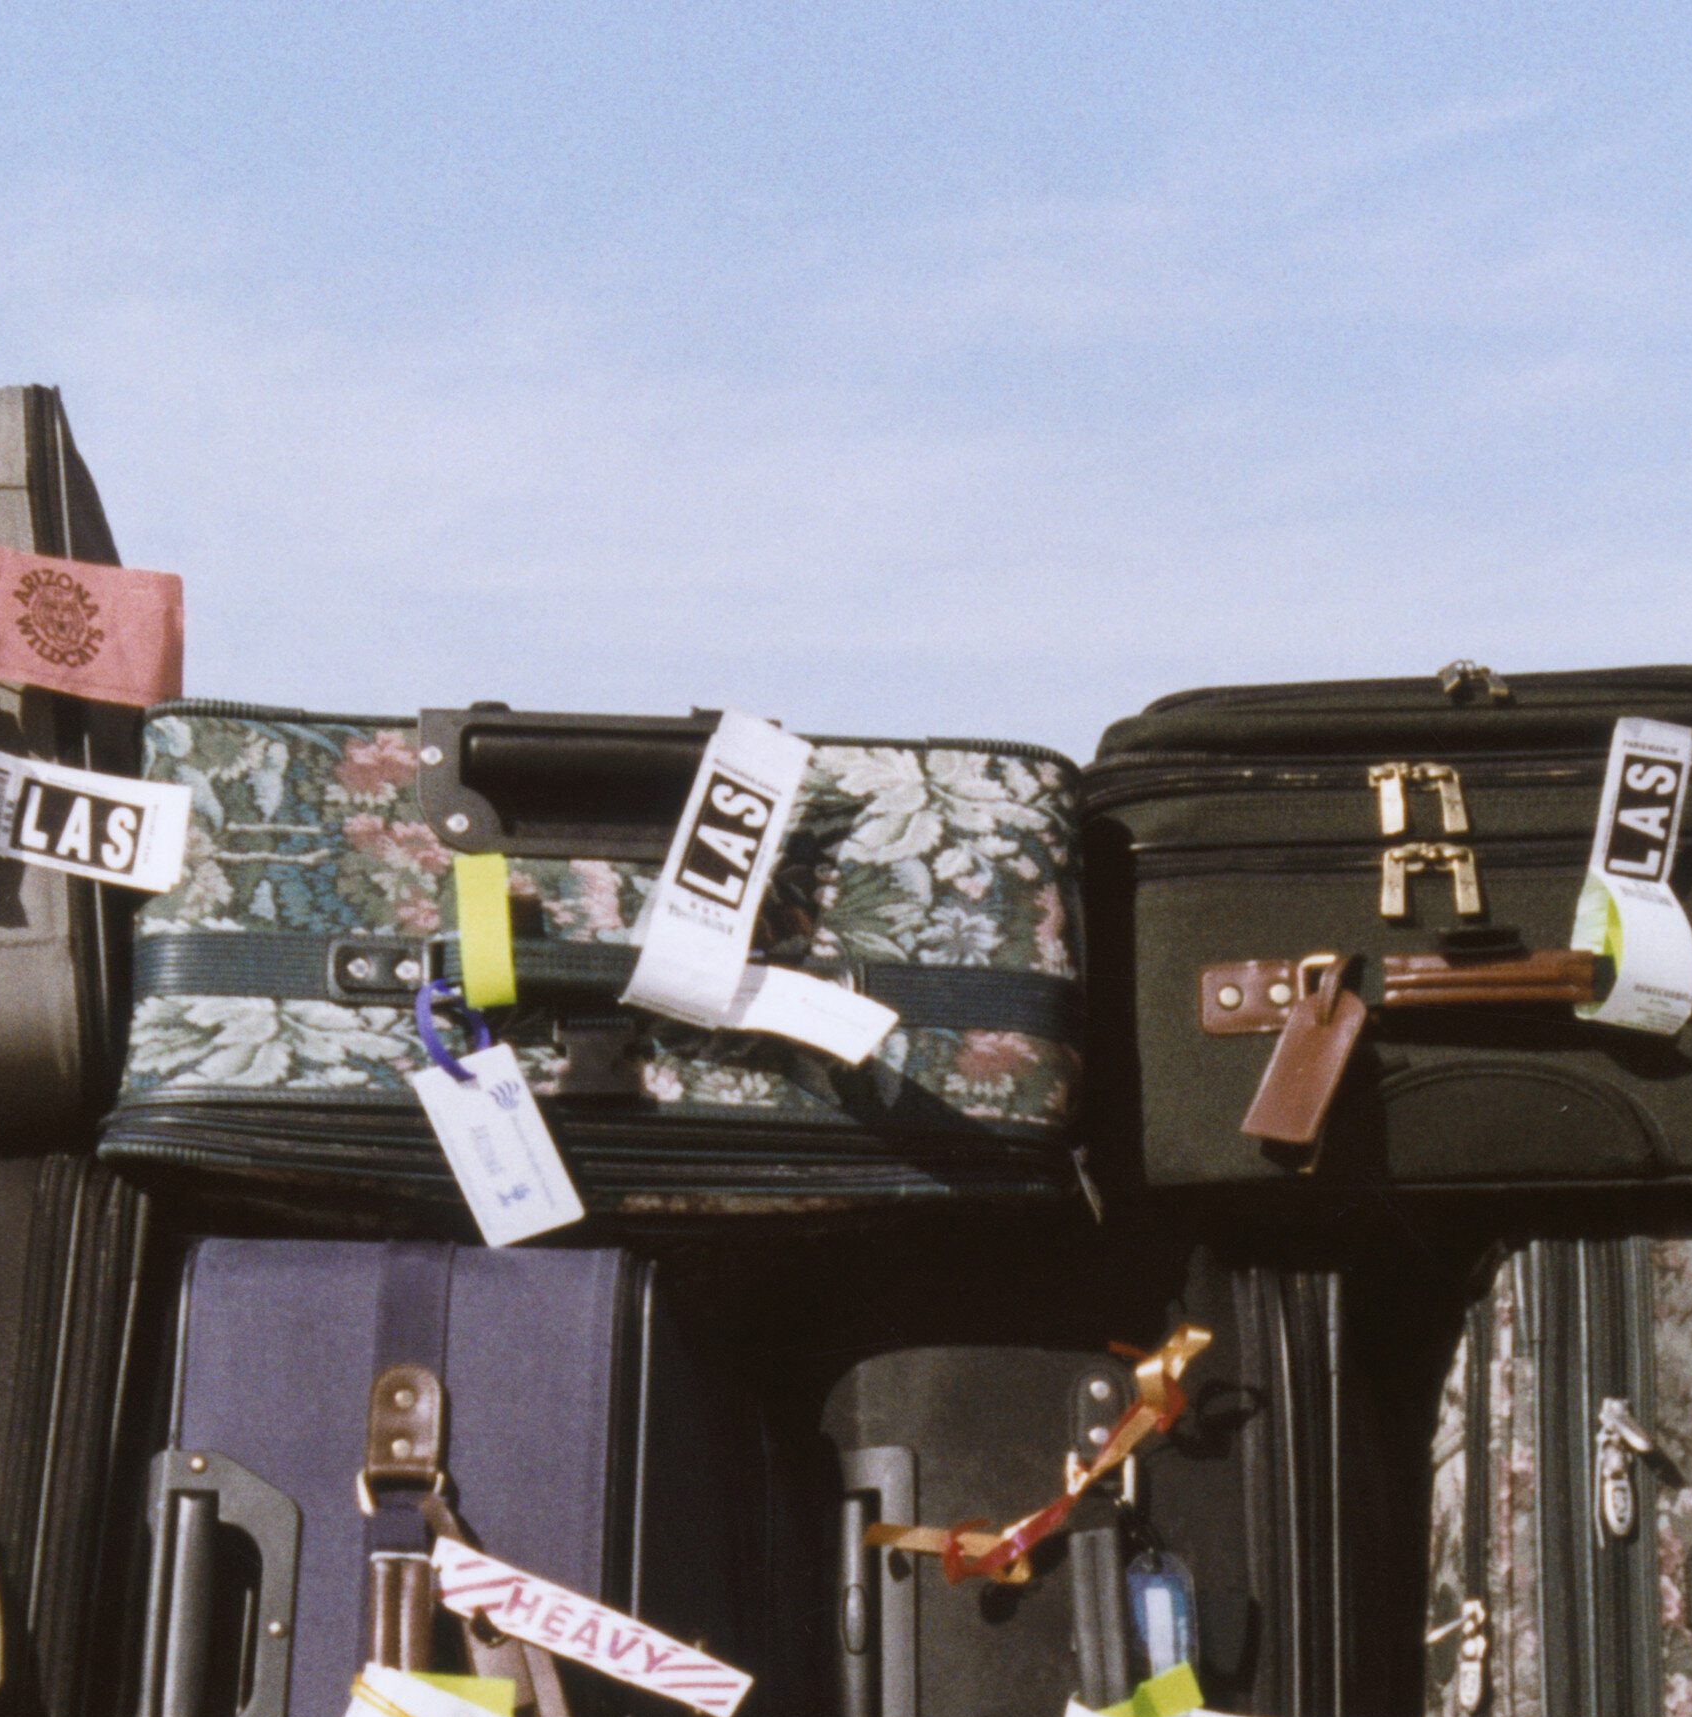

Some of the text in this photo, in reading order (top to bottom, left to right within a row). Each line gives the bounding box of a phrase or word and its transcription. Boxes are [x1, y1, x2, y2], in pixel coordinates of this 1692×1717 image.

[13, 568, 100, 621] ARIZONA
[15, 614, 105, 668] WILDCATS
[20, 785, 137, 870] LAS
[681, 784, 769, 903] LAS
[1609, 762, 1679, 877] LAS
[504, 1584, 672, 1674] HEAVY
